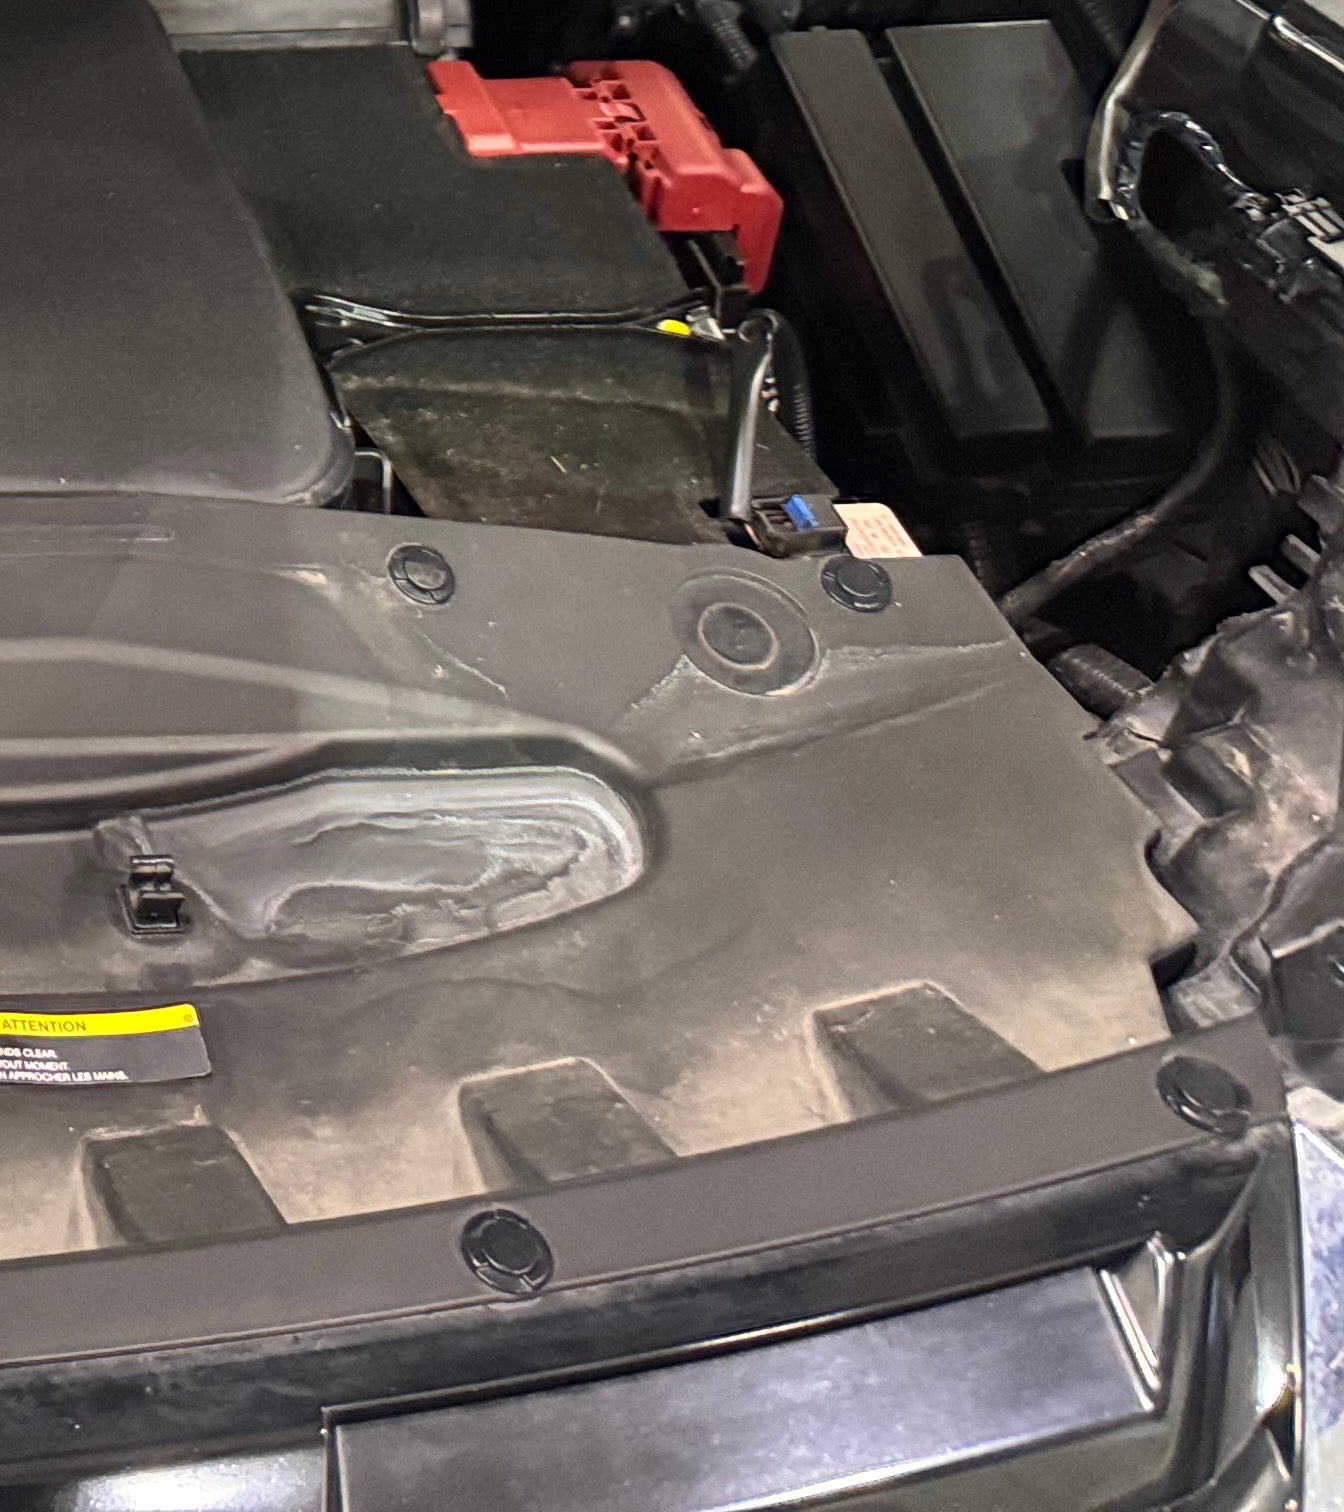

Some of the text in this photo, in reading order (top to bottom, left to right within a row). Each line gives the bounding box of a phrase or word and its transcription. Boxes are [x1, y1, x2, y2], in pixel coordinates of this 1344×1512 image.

[3, 1019, 87, 1033] ATTENTION
[23, 1048, 59, 1059] CLEAR.
[9, 1071, 71, 1082] APPROCHER
[72, 1072, 91, 1082] LES
